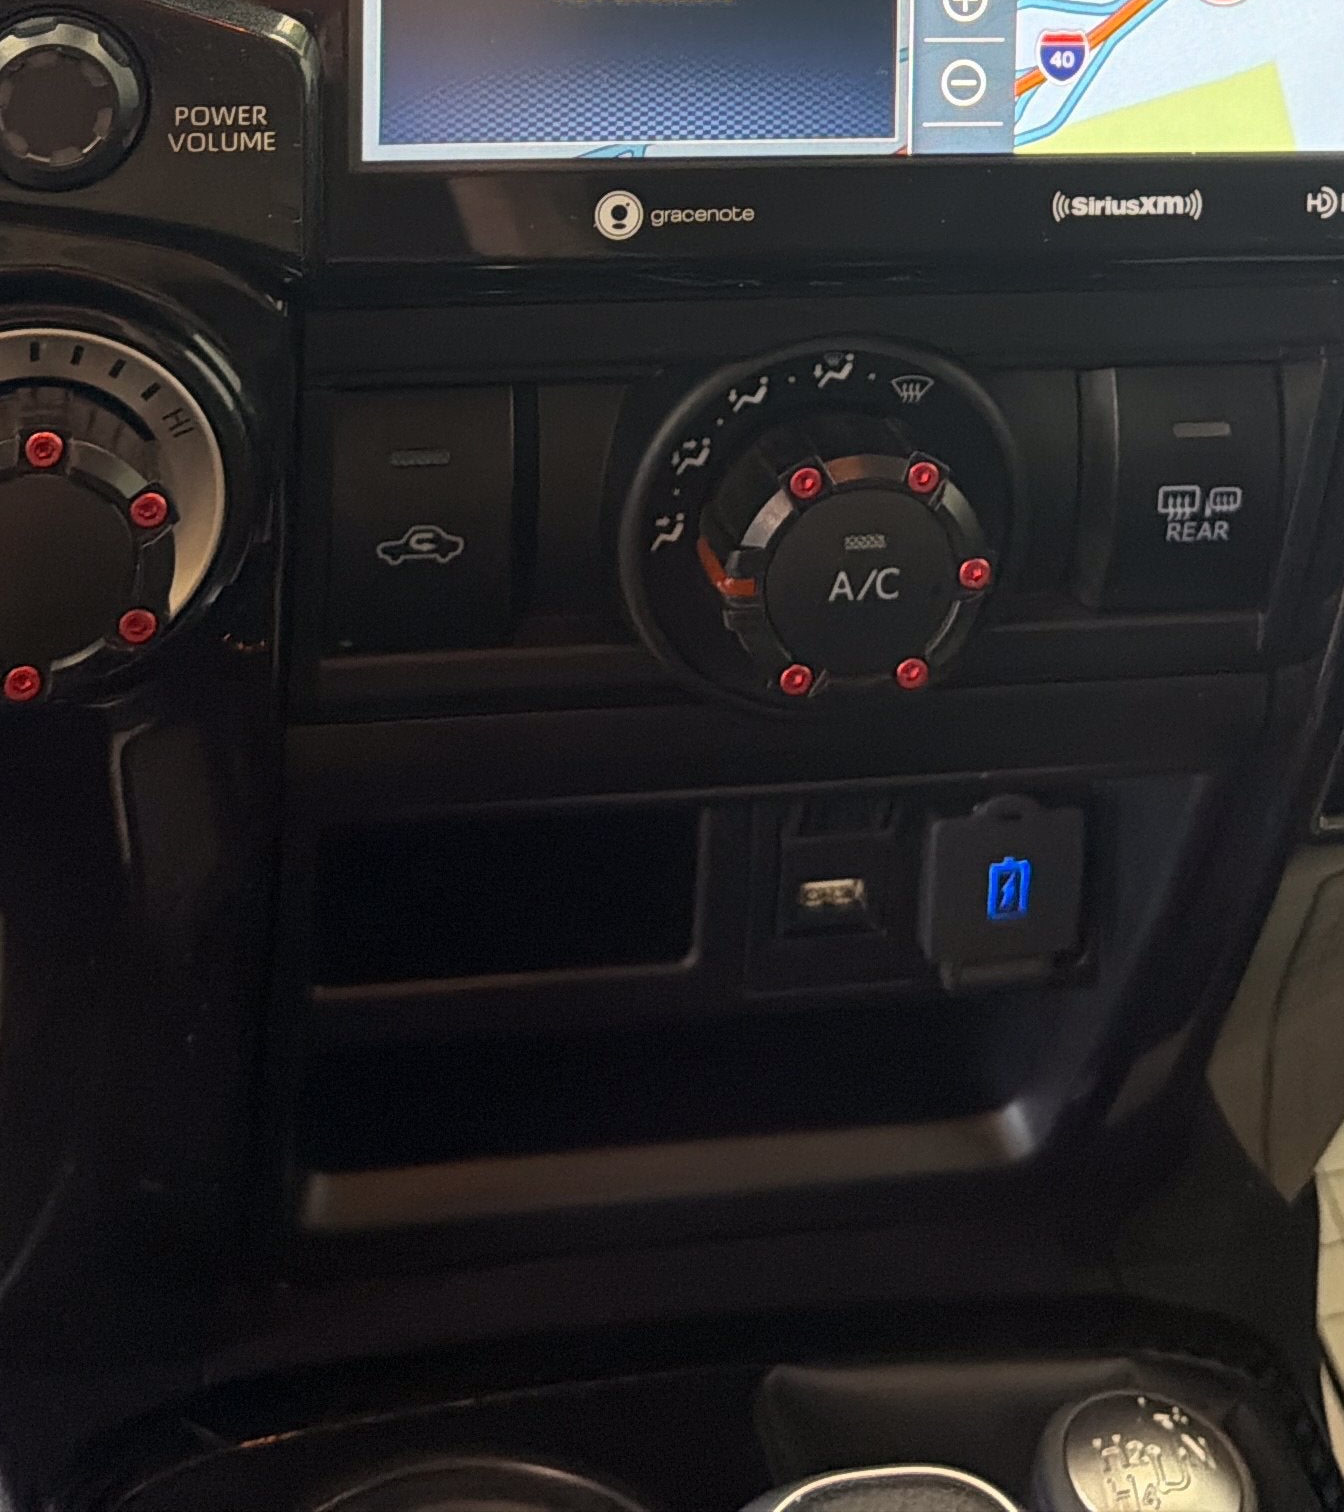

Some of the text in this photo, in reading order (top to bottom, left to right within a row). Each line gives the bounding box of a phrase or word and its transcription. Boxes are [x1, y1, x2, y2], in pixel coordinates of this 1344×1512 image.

[1050, 51, 1074, 68] 40
[175, 106, 268, 127] POWER
[168, 131, 276, 153] VOLUME
[650, 204, 754, 226] gracenote
[162, 408, 194, 437] HI
[1166, 521, 1229, 542] REAR
[829, 568, 899, 601] A/C
